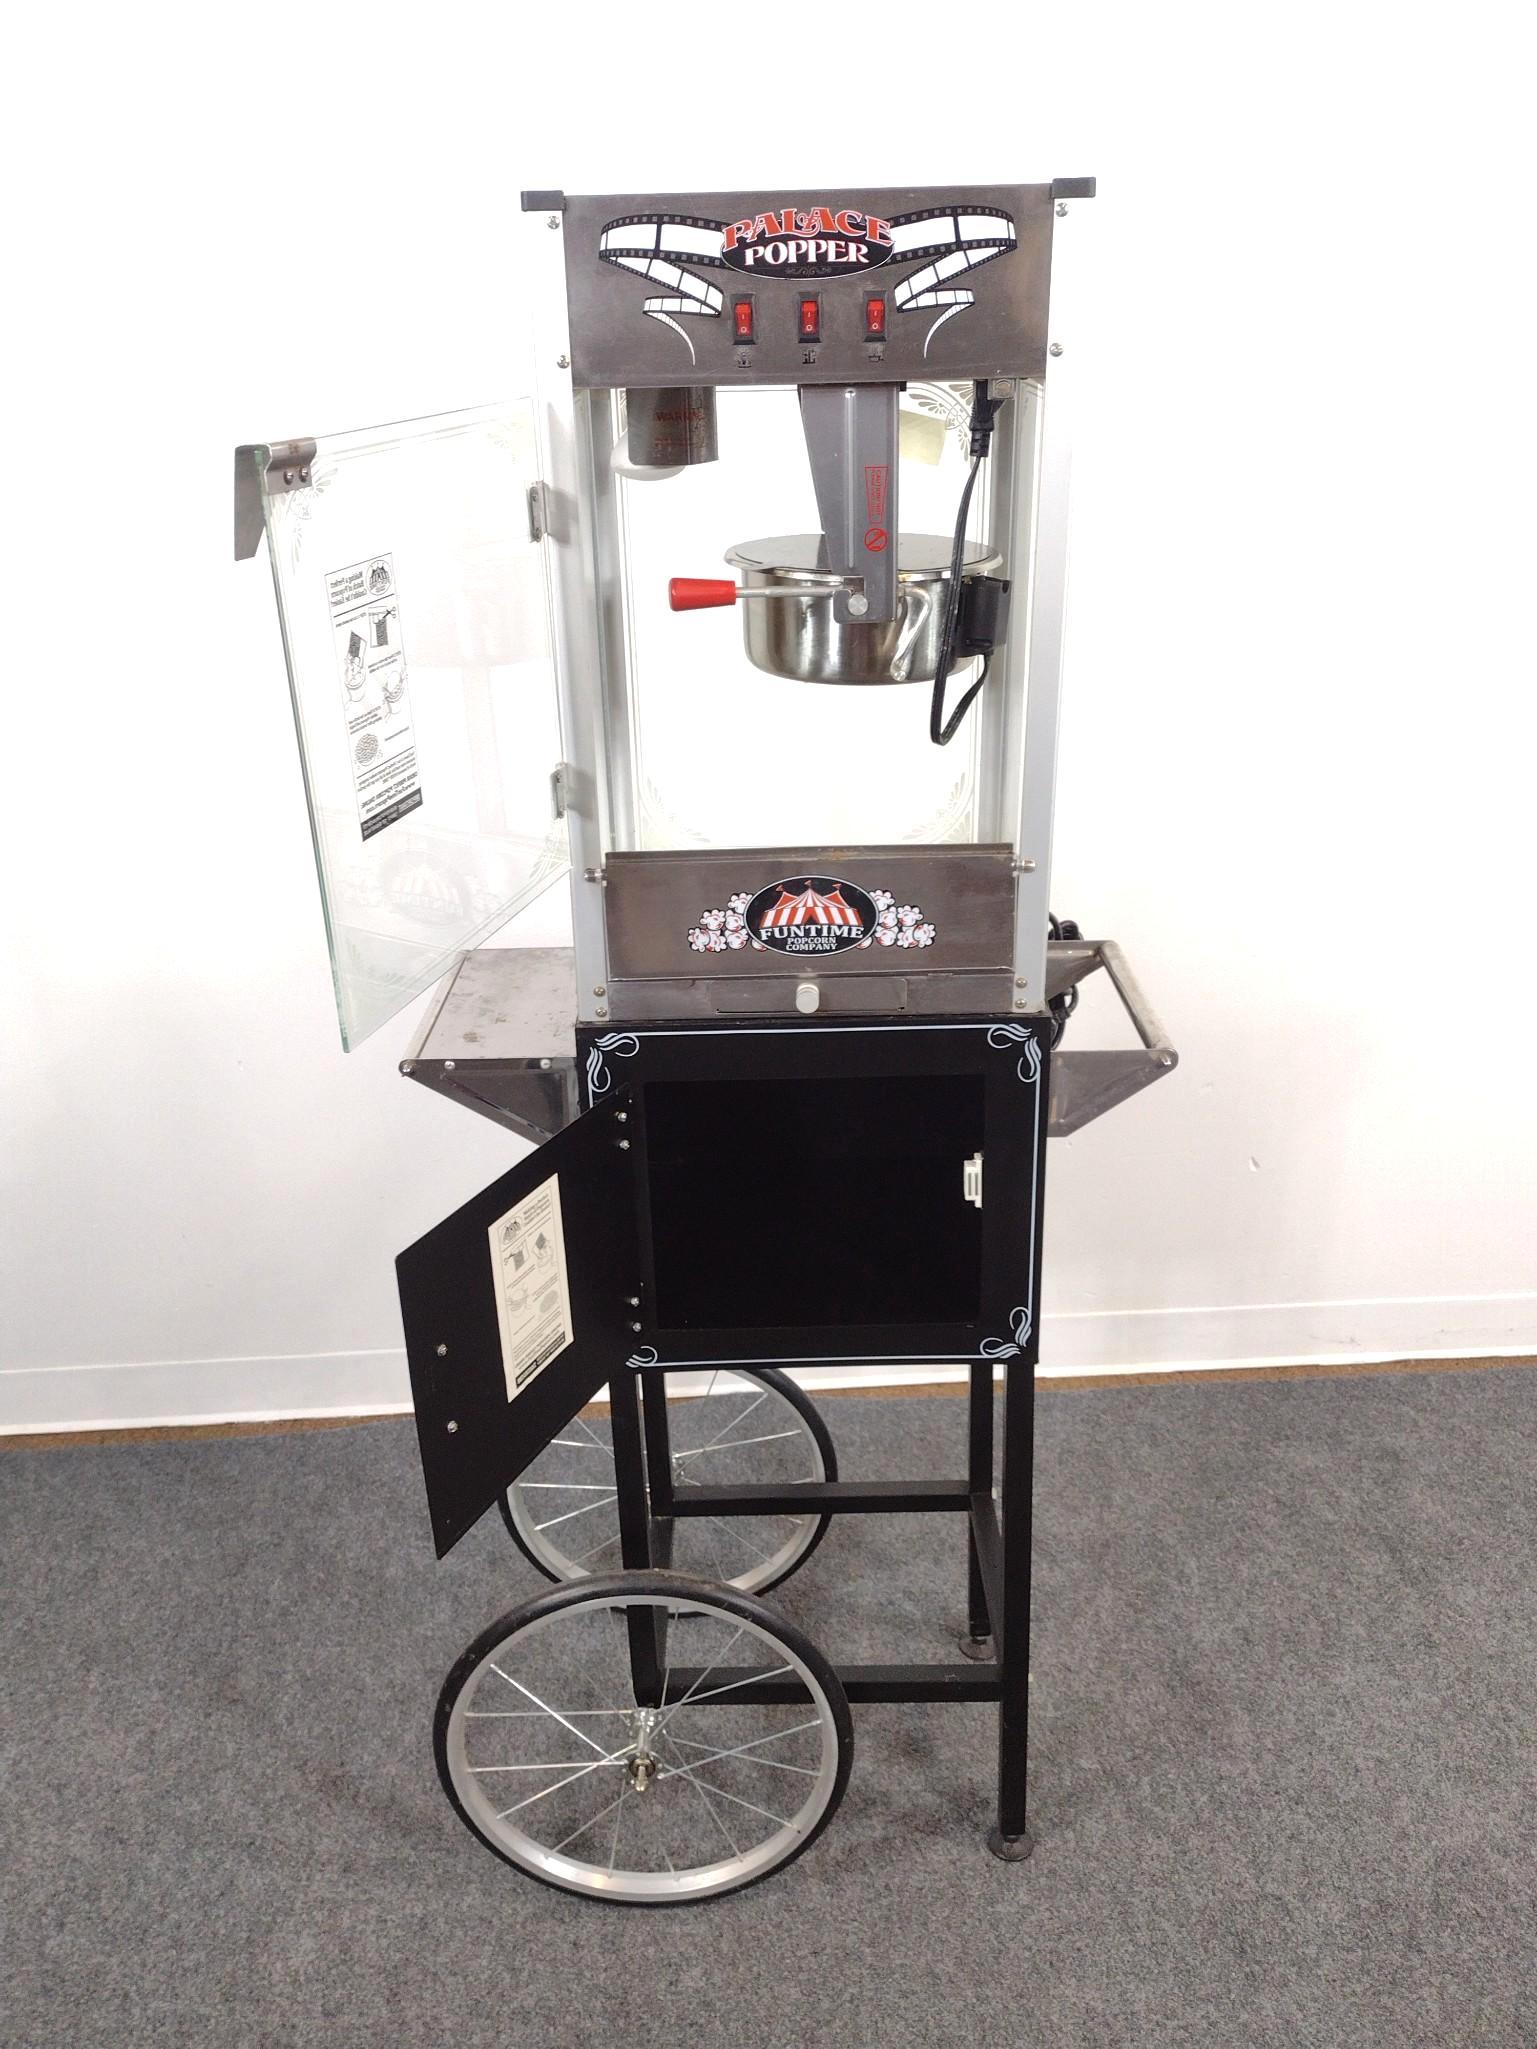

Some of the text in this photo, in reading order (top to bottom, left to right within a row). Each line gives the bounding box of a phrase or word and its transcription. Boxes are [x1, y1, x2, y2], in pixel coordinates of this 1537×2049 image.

[722, 207, 894, 252] PALACE
[744, 239, 870, 266] POPPER
[759, 924, 864, 941] FUNTIME
[787, 937, 837, 945] POPCORN
[786, 943, 838, 951] COMPANY
